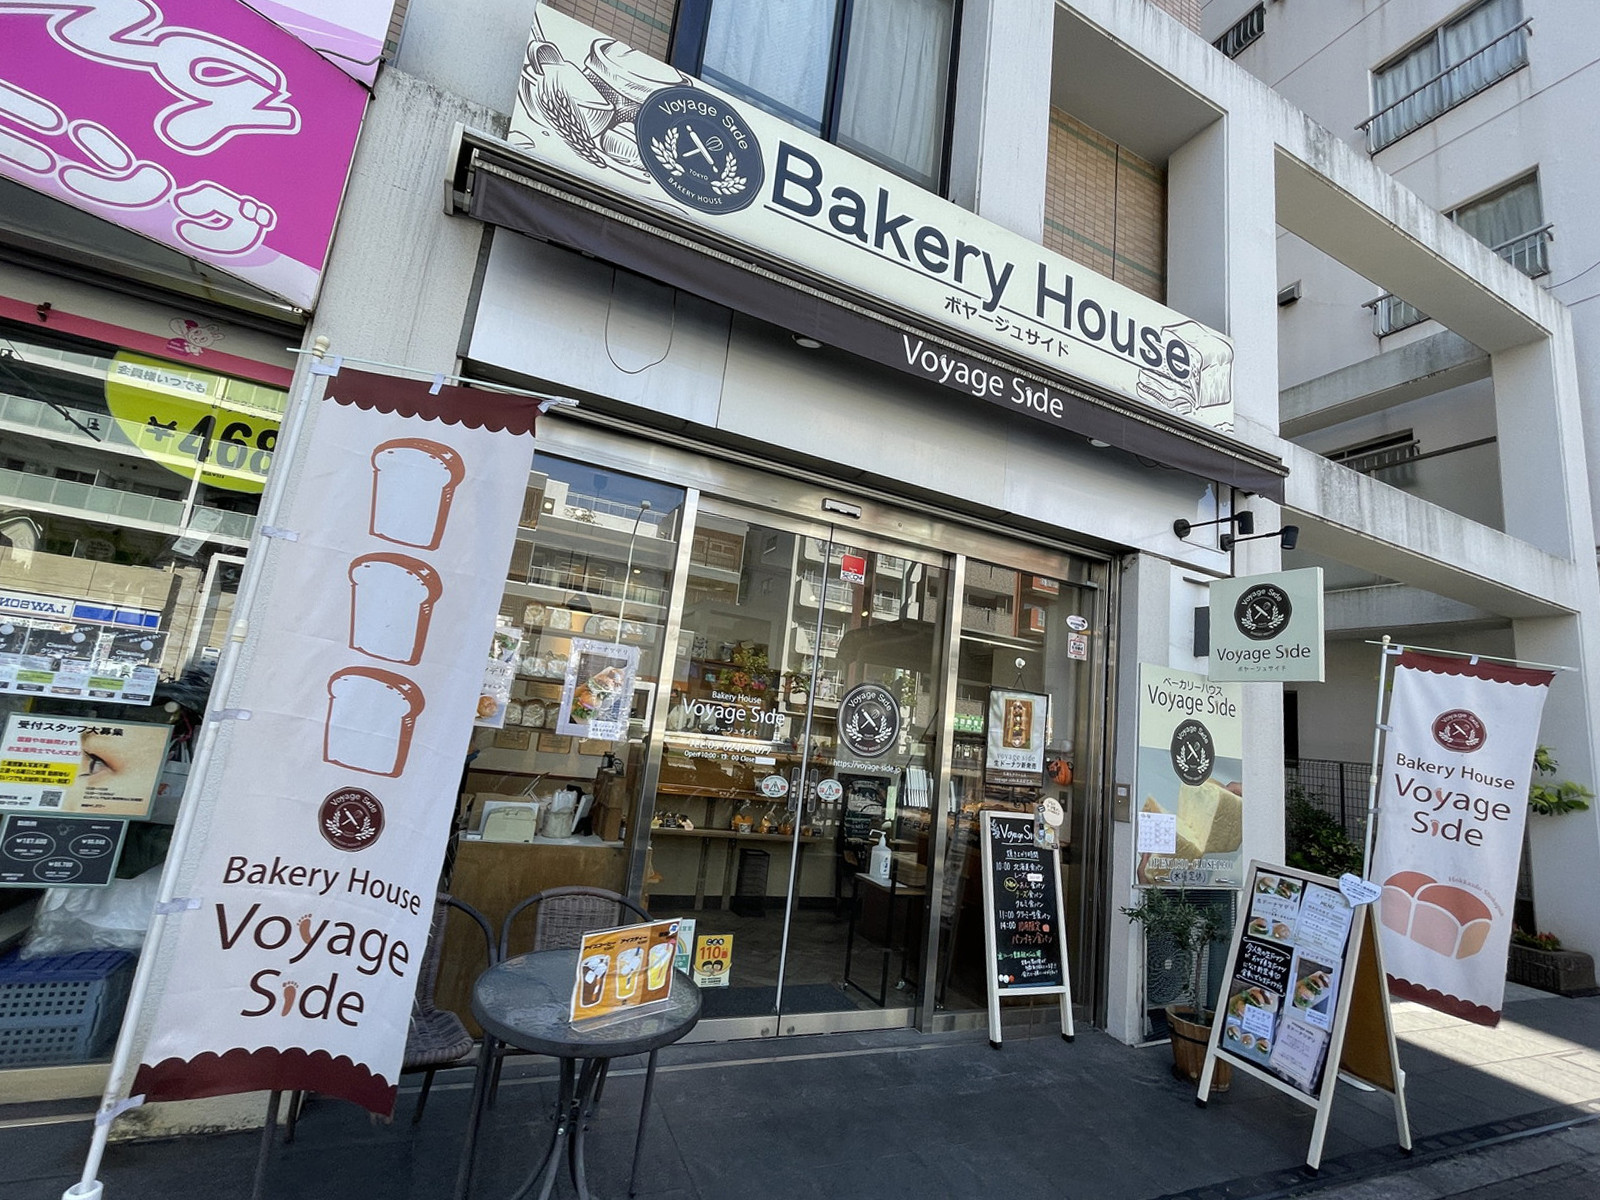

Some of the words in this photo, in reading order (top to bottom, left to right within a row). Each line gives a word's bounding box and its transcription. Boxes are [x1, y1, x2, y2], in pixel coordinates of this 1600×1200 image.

[658, 99, 718, 117] Voyage
[722, 114, 749, 150] Side
[688, 168, 709, 181] TOKYO
[667, 176, 697, 199] BAKERY
[697, 194, 724, 206] HOUSE
[771, 140, 1014, 312] Bakery
[1035, 261, 1193, 380] House
[943, 294, 1070, 358] ボヤージュサイド
[117, 364, 206, 394] 会員様いつでも
[901, 334, 1004, 399] Voyage
[1010, 377, 1065, 419] Side
[1241, 588, 1266, 606] Voyage
[1267, 588, 1283, 602] Side
[1216, 647, 1271, 664] Voyage
[1275, 643, 1311, 659] Side
[711, 690, 737, 703] Bakery
[737, 693, 762, 704] House
[848, 690, 876, 708] Voyage
[877, 692, 892, 712] Side
[1147, 684, 1204, 716] Voyage
[1207, 695, 1236, 718] Side
[1163, 677, 1224, 697] ベーカリーハウス
[682, 697, 747, 724] Voyage
[750, 706, 786, 726] Side
[17, 720, 124, 737] 受付スタッフ大募集
[1176, 725, 1197, 740] Voyage
[1396, 752, 1456, 780] Bakery
[1460, 765, 1516, 790] House
[329, 793, 361, 806] Voyage
[361, 796, 377, 814] Side
[1394, 773, 1512, 822] Voyage
[1411, 810, 1484, 847] Side
[222, 855, 340, 896] Bakery
[347, 867, 422, 916] House
[215, 903, 410, 977] Voyage
[240, 968, 366, 1027] Side
